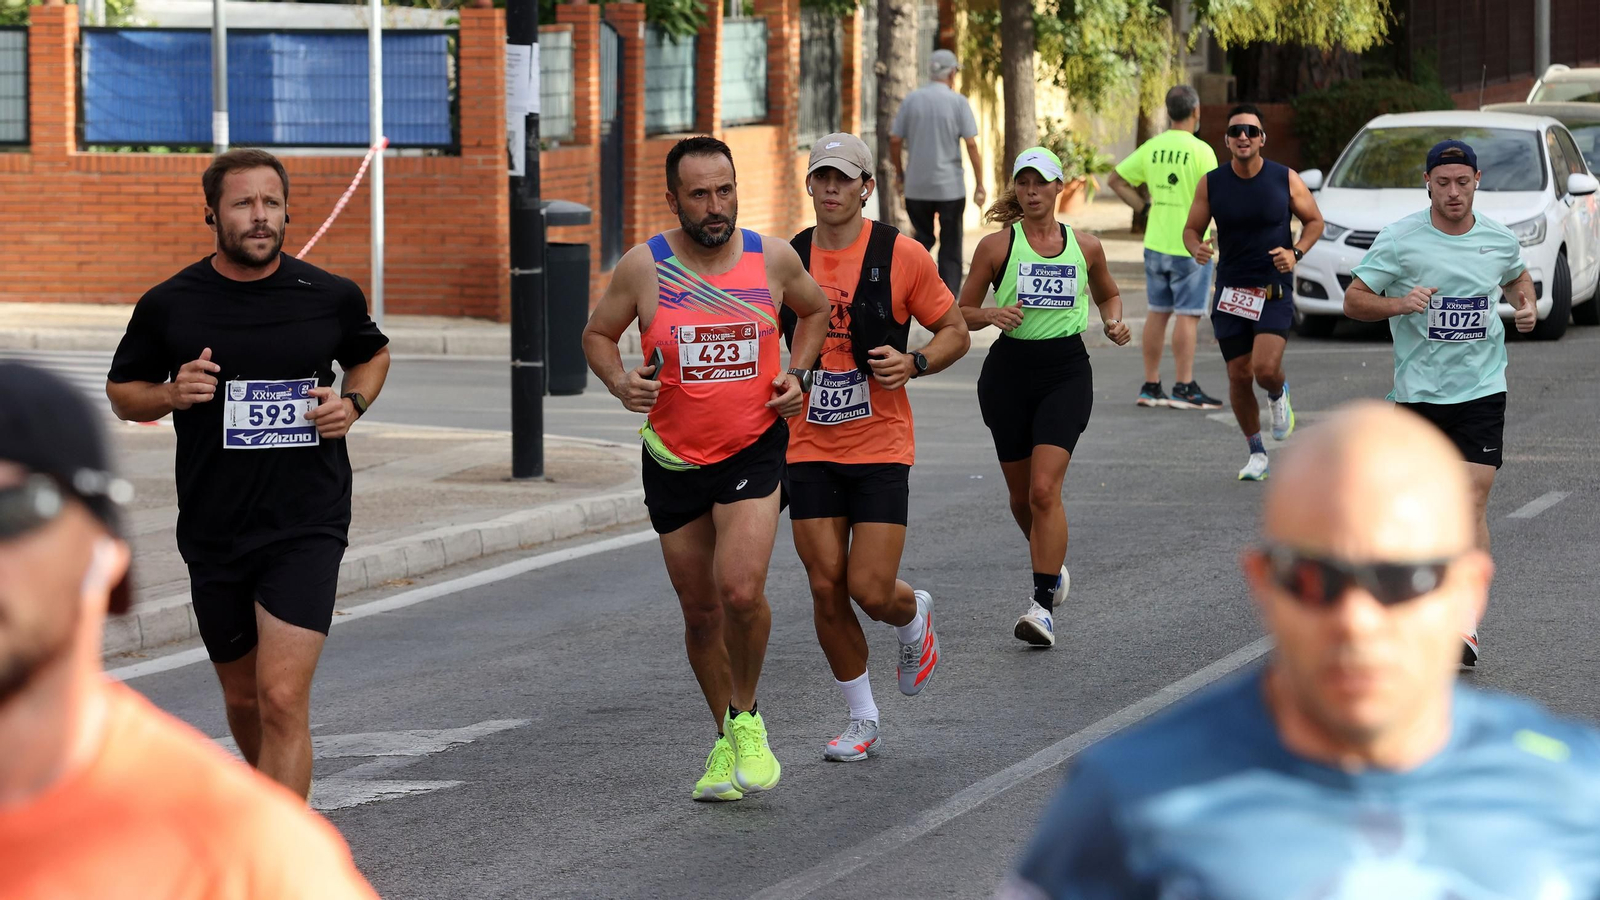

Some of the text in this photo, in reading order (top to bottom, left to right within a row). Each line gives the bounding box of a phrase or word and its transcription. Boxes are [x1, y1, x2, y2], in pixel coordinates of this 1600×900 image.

[1152, 150, 1189, 165] STAFF
[1032, 278, 1063, 294] 943
[1039, 298, 1072, 306] MIZUNO
[1231, 292, 1254, 307] 523
[1439, 311, 1481, 327] 1072
[699, 343, 740, 363] 423
[709, 367, 752, 379] MIZUNO
[820, 387, 854, 407] 867
[249, 403, 296, 426] 593
[827, 407, 866, 421] MIZUNO
[259, 432, 312, 444] MIZUNO
